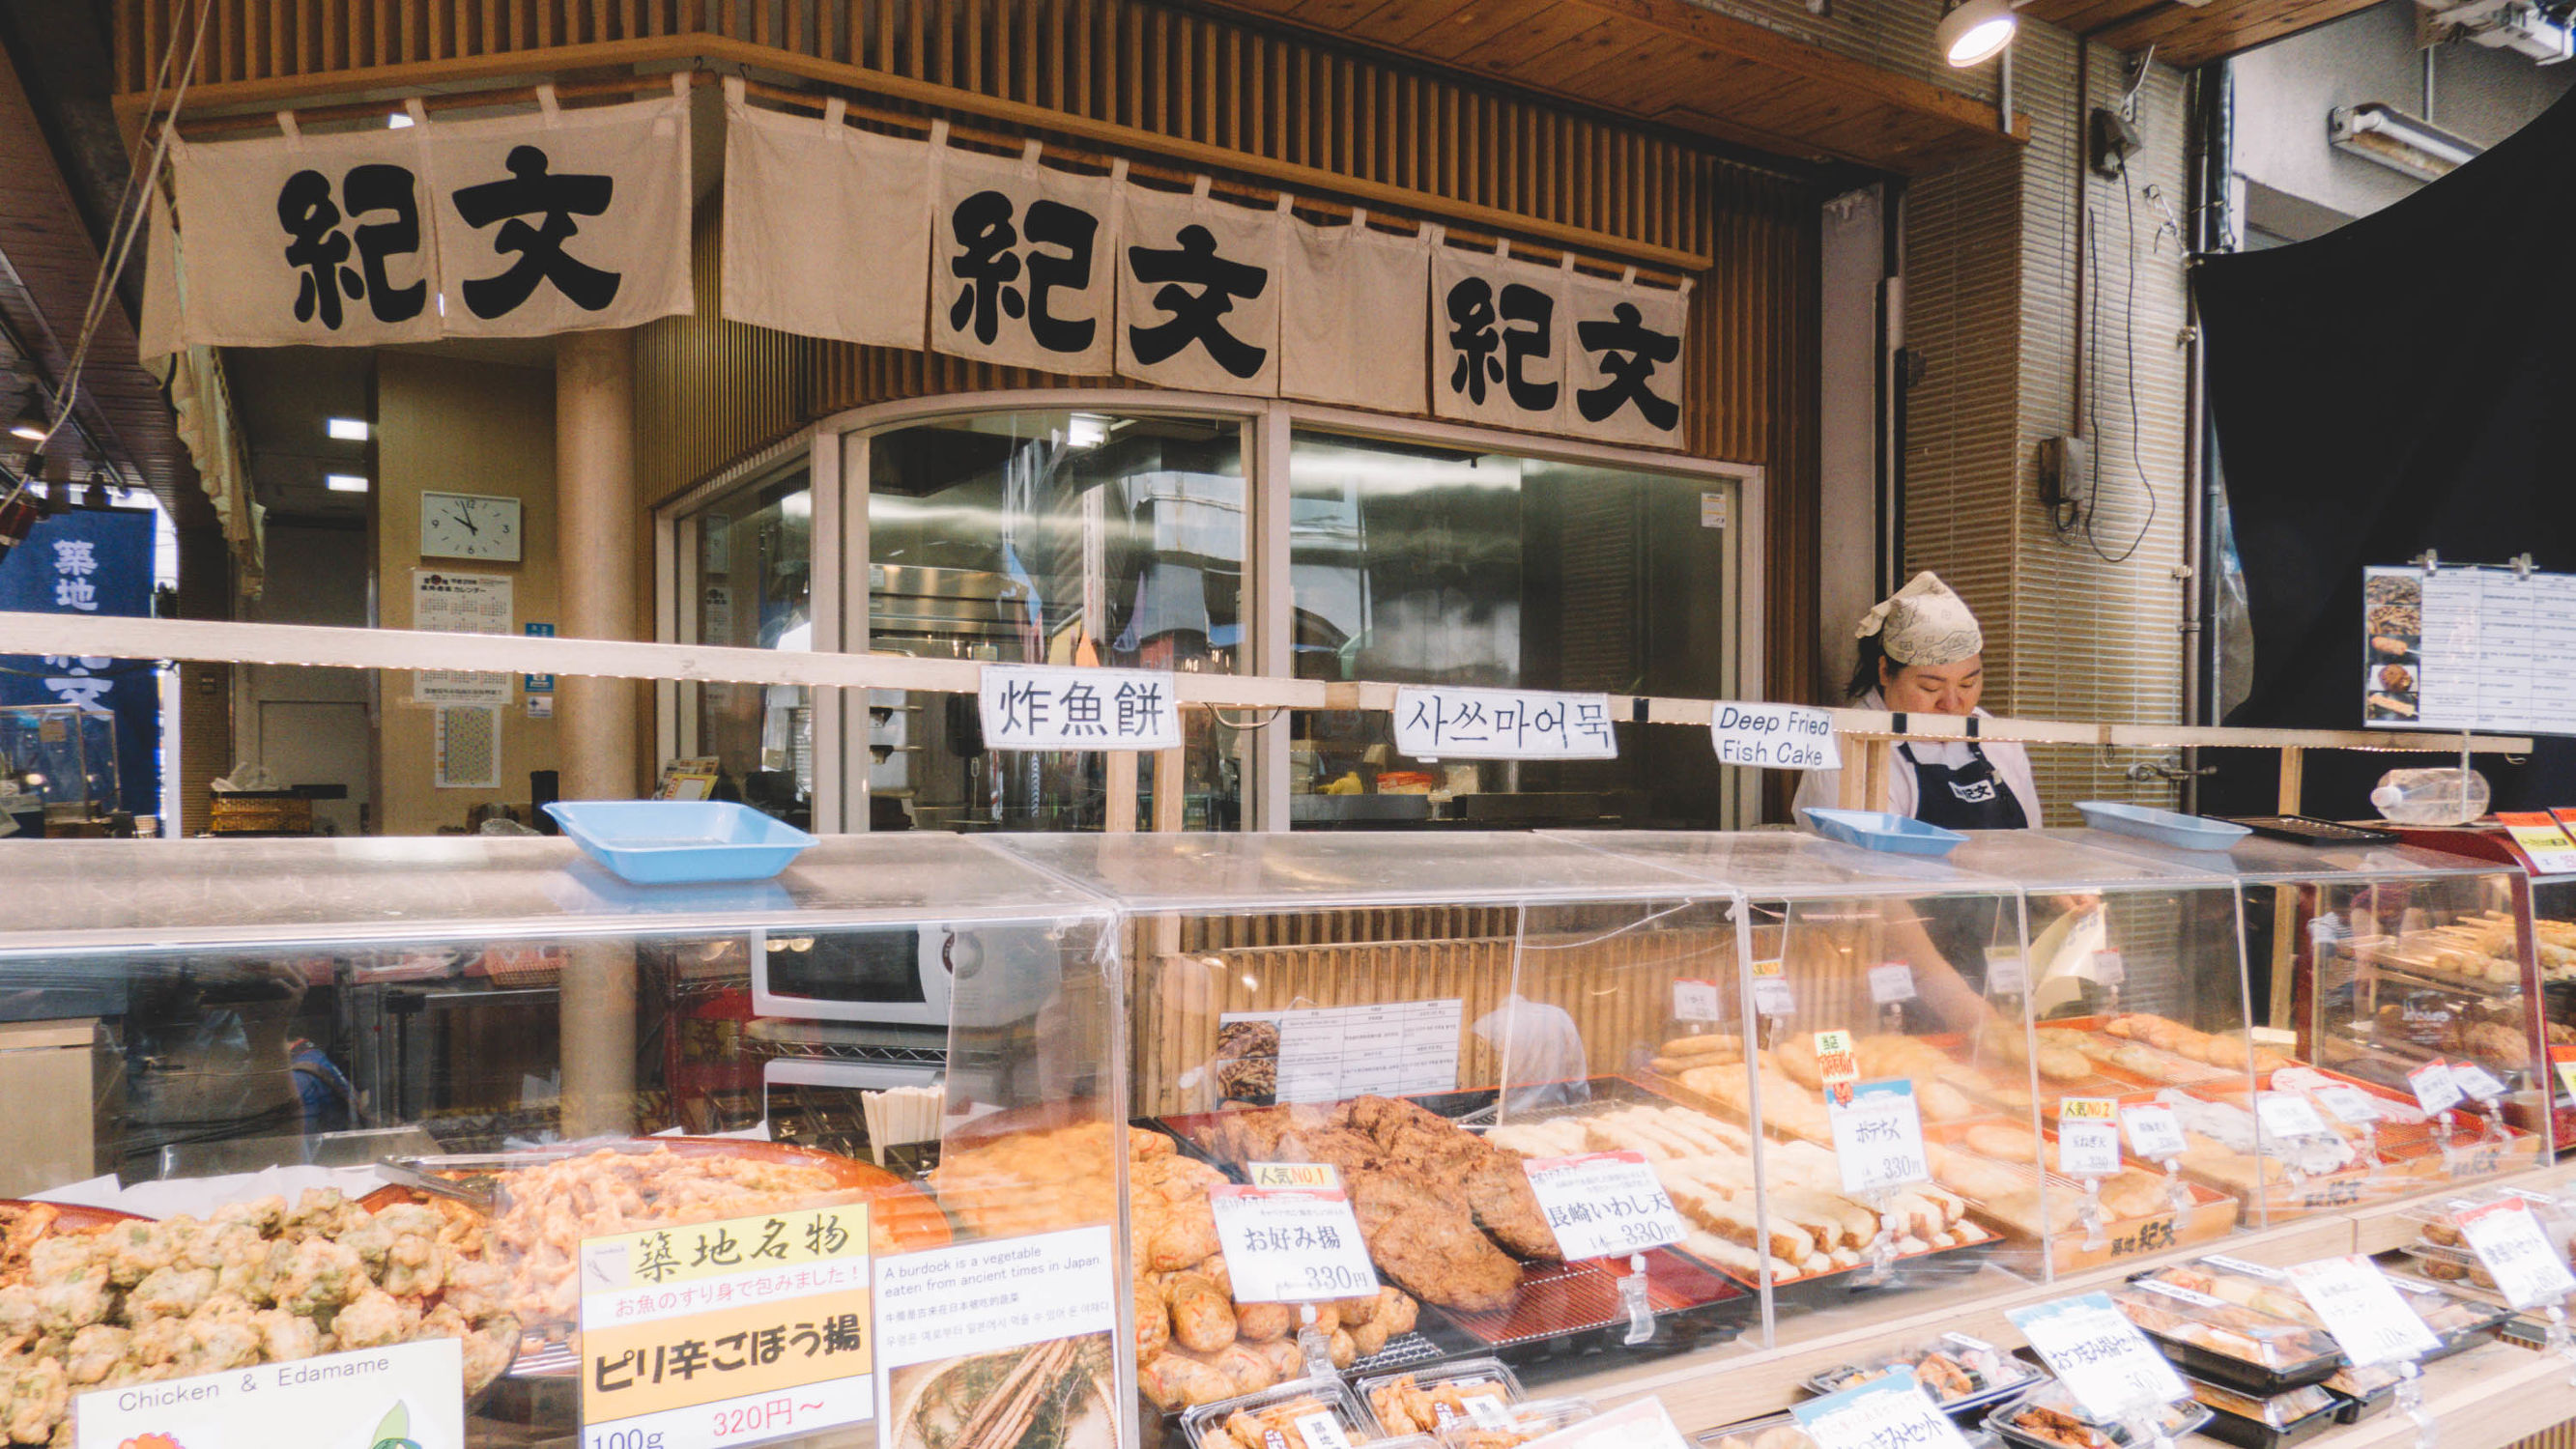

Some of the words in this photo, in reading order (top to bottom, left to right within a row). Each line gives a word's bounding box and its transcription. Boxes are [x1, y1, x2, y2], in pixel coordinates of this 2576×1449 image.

[277, 145, 621, 330] 紀文
[950, 190, 1269, 379] 紀文
[1446, 276, 1680, 432] 紀文
[431, 519, 441, 528] 9
[467, 499, 476, 509] 12
[501, 524, 510, 534] 3
[467, 545, 475, 554] 6
[999, 679, 1164, 737] 炸魚餅
[1405, 694, 1609, 750] 사쓰마어묵
[1718, 706, 1780, 734] Deep
[1787, 711, 1831, 736] Fried
[1723, 740, 1768, 763] Fish
[1776, 743, 1823, 766] Cake
[1548, 1190, 1672, 1229] 長崎いわし天
[635, 1213, 849, 1283] 築地名物
[1245, 1225, 1341, 1252] お好み揚
[884, 1267, 895, 1280] A
[899, 1260, 951, 1278] burdock
[955, 1259, 967, 1269] is
[970, 1258, 979, 1267] a
[983, 1246, 1042, 1265] vegetable
[885, 1282, 922, 1298] eaten
[927, 1276, 957, 1293] from
[960, 1269, 1007, 1286] ancient
[1011, 1263, 1045, 1277] times
[1048, 1260, 1060, 1271] in
[1064, 1255, 1100, 1271] Japan
[1304, 1265, 1368, 1291] 330円
[595, 1313, 862, 1393] ピリ辛ごぼう揚
[118, 1382, 220, 1412] Chicken
[240, 1373, 258, 1393] &
[278, 1357, 390, 1387] Edamame
